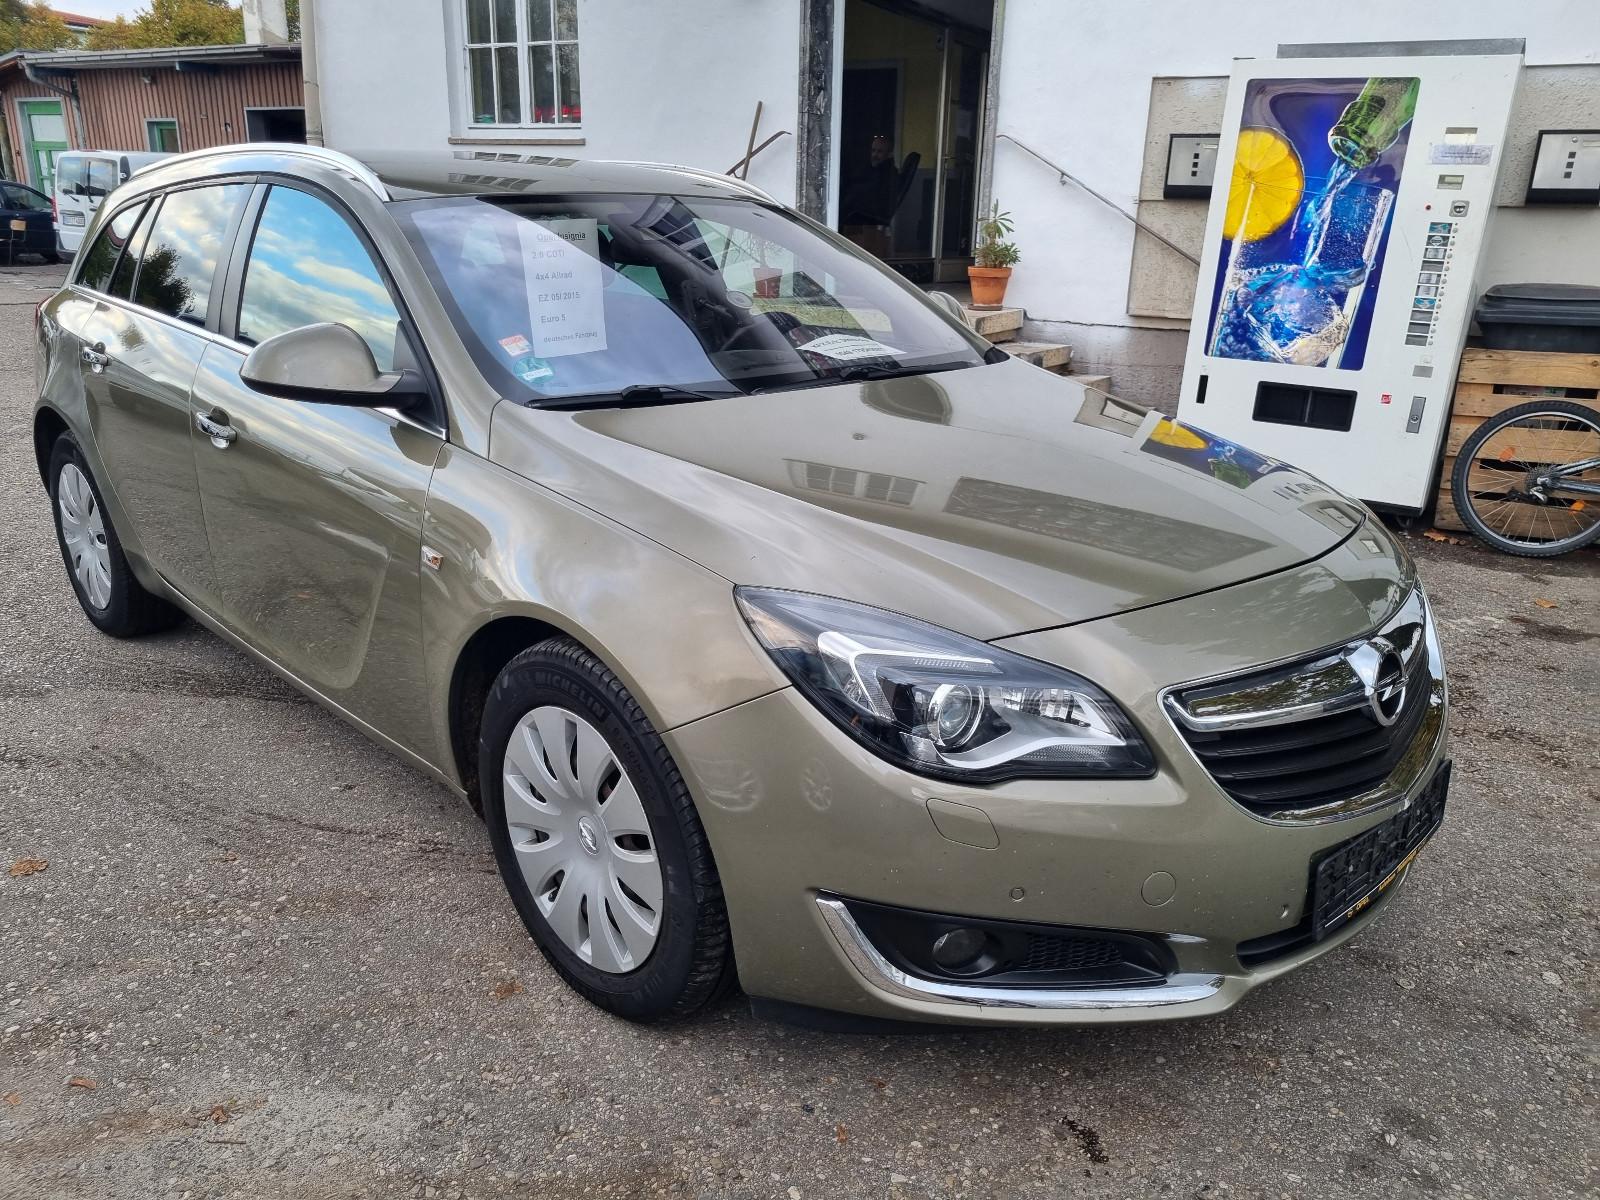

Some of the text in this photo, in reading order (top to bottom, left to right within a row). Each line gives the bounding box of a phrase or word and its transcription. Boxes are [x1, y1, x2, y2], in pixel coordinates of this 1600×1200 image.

[535, 273, 550, 281] 4x4
[538, 294, 550, 303] EZ
[540, 315, 560, 324] Euro
[535, 671, 608, 718] MICHELIN
